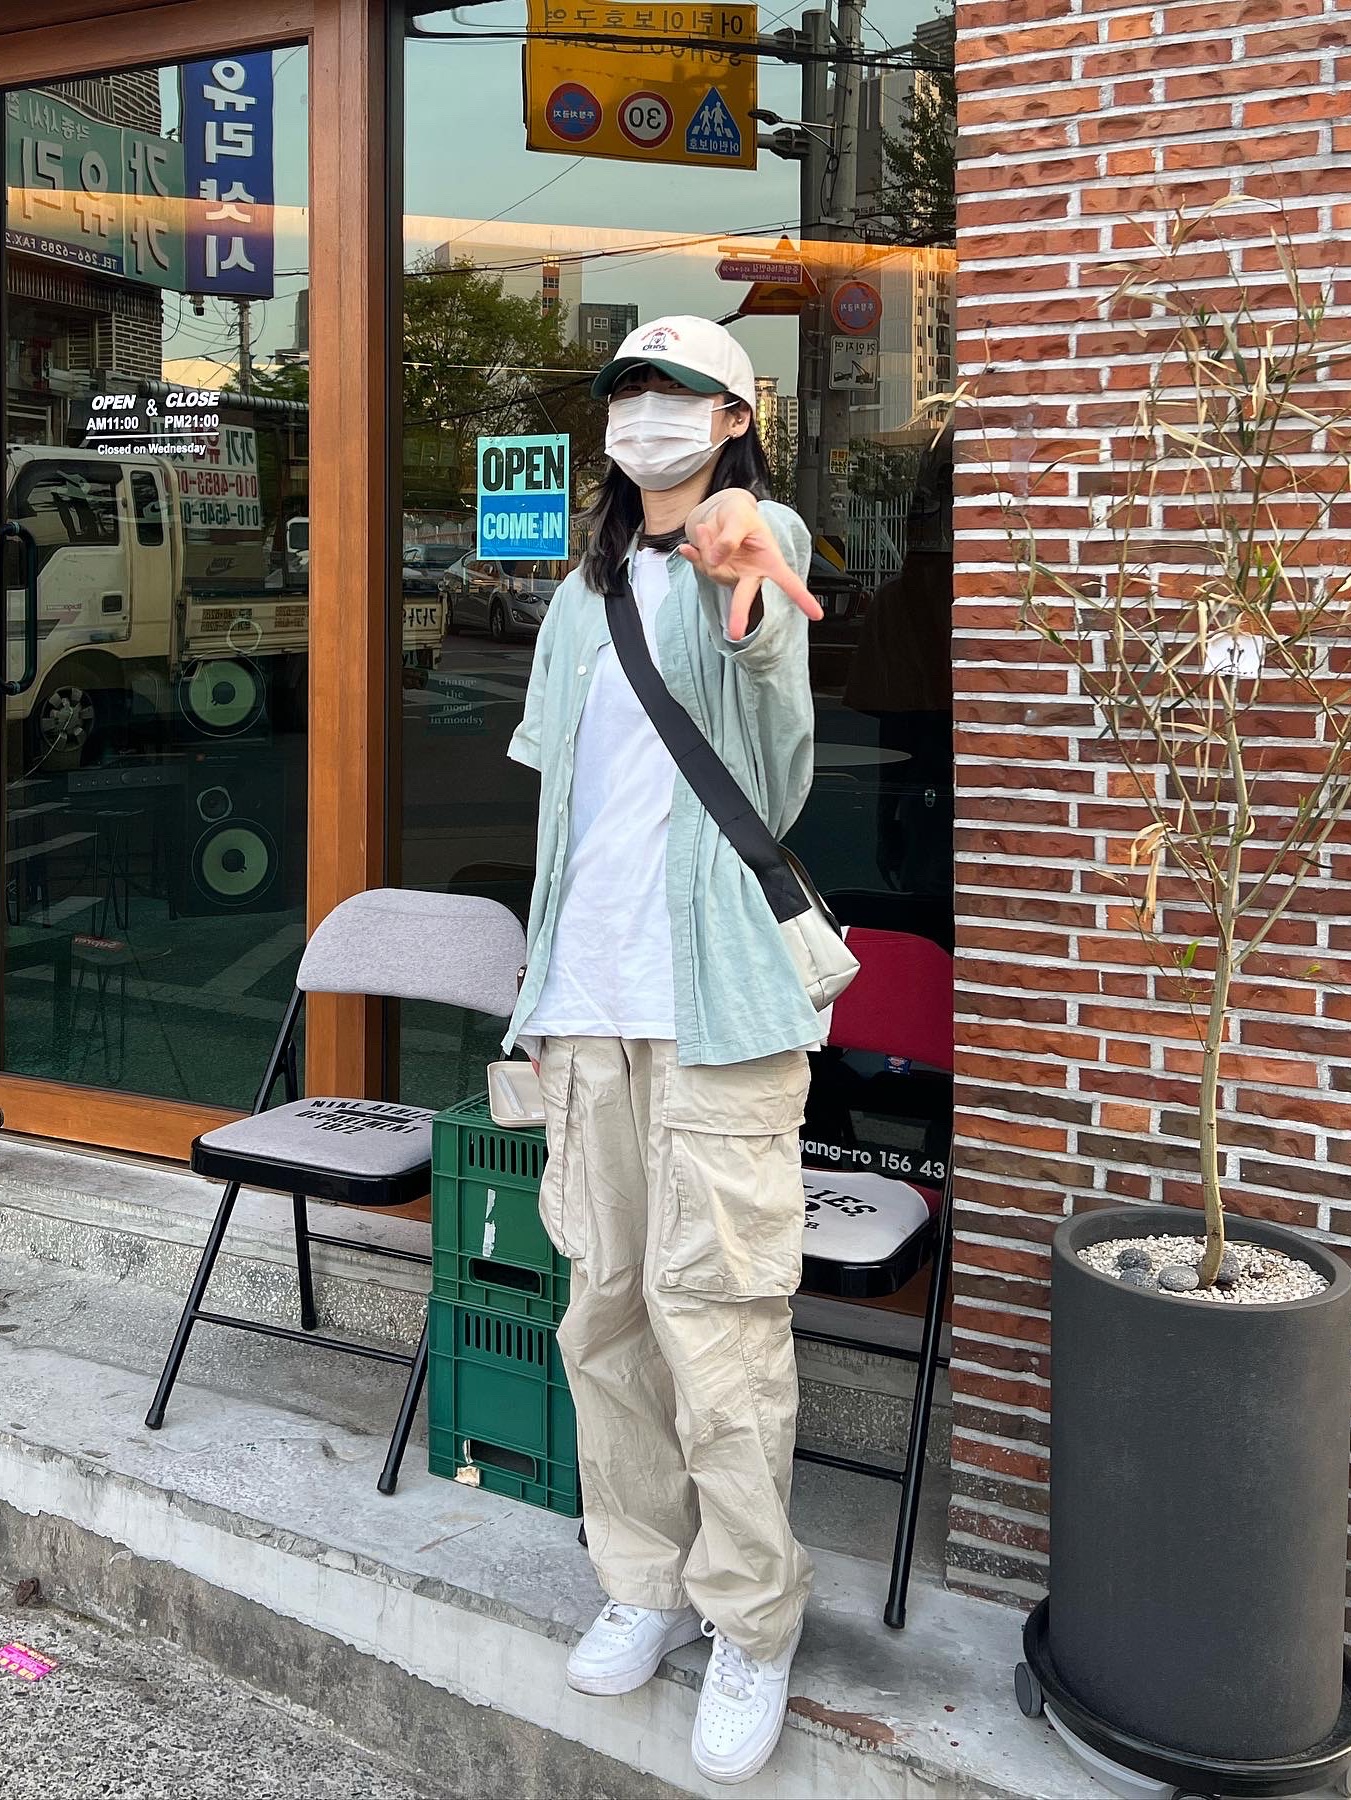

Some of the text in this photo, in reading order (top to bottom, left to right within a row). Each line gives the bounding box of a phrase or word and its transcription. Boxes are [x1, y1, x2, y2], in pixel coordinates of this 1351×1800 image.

[91, 391, 221, 417] OPEN & CLOSE
[86, 413, 219, 431] AM11:00 PM21:00
[97, 442, 207, 455] Closed on Wednesday
[482, 445, 565, 492] OPEN
[482, 511, 563, 540] COME IN
[439, 677, 477, 688] change
[446, 689, 463, 699] the
[443, 701, 472, 711] mood
[430, 715, 484, 727] in moodsy
[310, 1100, 364, 1110] NIKE
[295, 1110, 423, 1134] DEPARTMENT
[879, 1150, 912, 1172] 156
[919, 1160, 945, 1179] 43
